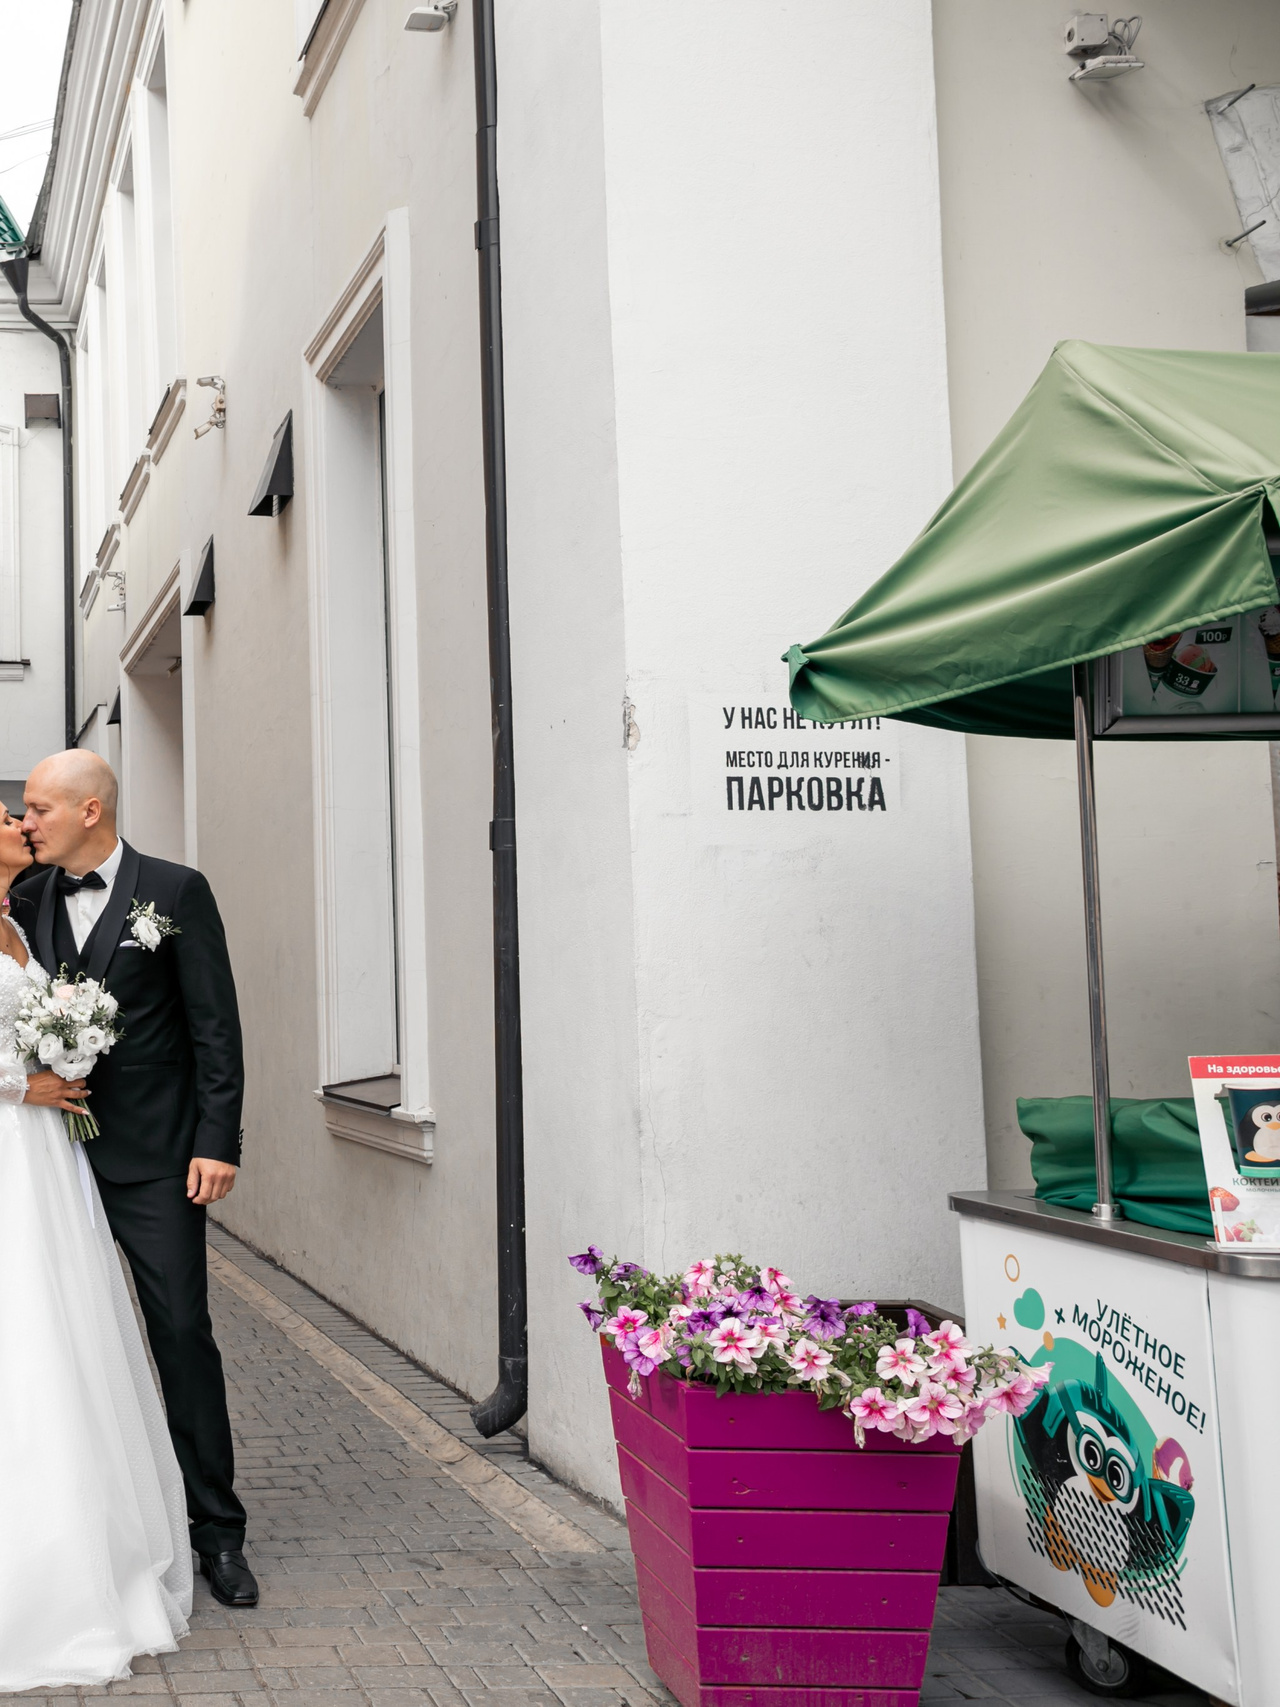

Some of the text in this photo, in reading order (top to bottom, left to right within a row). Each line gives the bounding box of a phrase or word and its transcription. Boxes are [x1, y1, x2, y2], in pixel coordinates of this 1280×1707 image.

[723, 707, 735, 729] У
[741, 707, 777, 729] НАС
[783, 707, 806, 730] НЕ
[726, 751, 773, 768] МЕСТО
[777, 751, 809, 769] ДЛЯ
[814, 752, 881, 769] КУРЕНИЯ
[726, 776, 887, 811] ПАРКОВКА
[1207, 1063, 1224, 1073] На
[1096, 1299, 1186, 1380] УЛЁТНОЕ
[1072, 1303, 1206, 1435] МОРОЖЕНОЕ!
